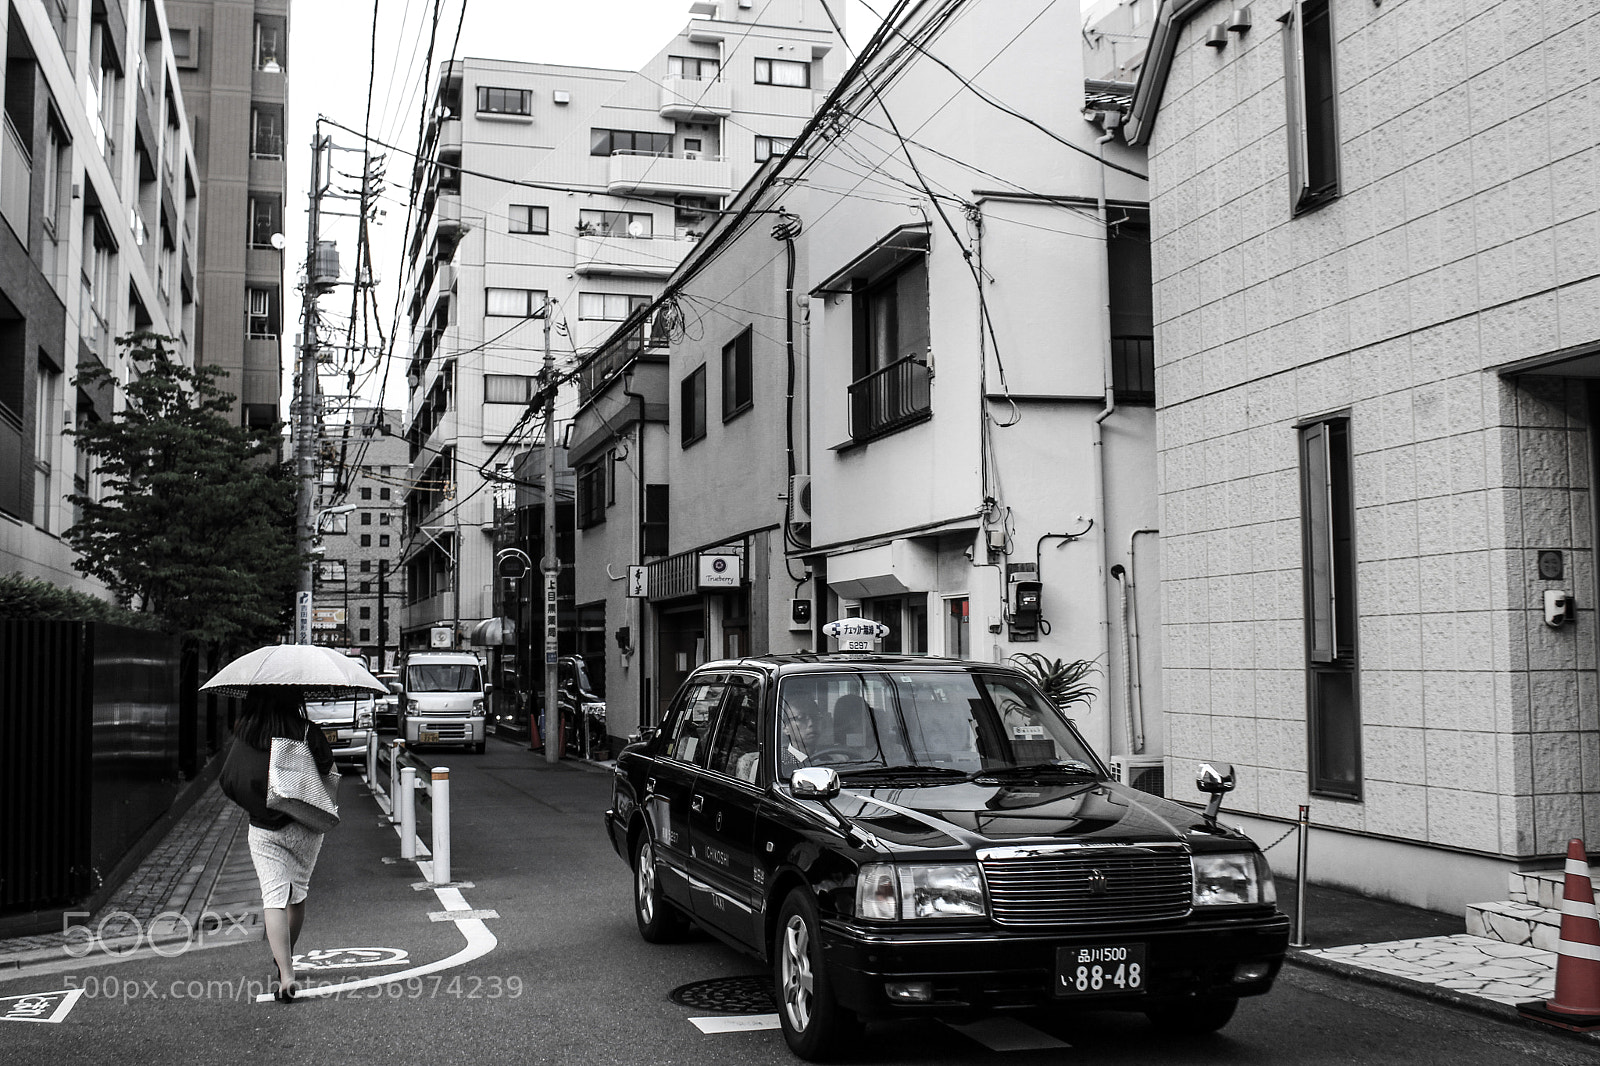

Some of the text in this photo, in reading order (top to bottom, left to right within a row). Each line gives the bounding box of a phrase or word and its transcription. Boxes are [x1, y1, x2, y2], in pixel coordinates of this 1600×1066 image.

[705, 575, 735, 585] Trueberry
[849, 641, 868, 650] 5297
[1060, 963, 1140, 991] い 88-48
